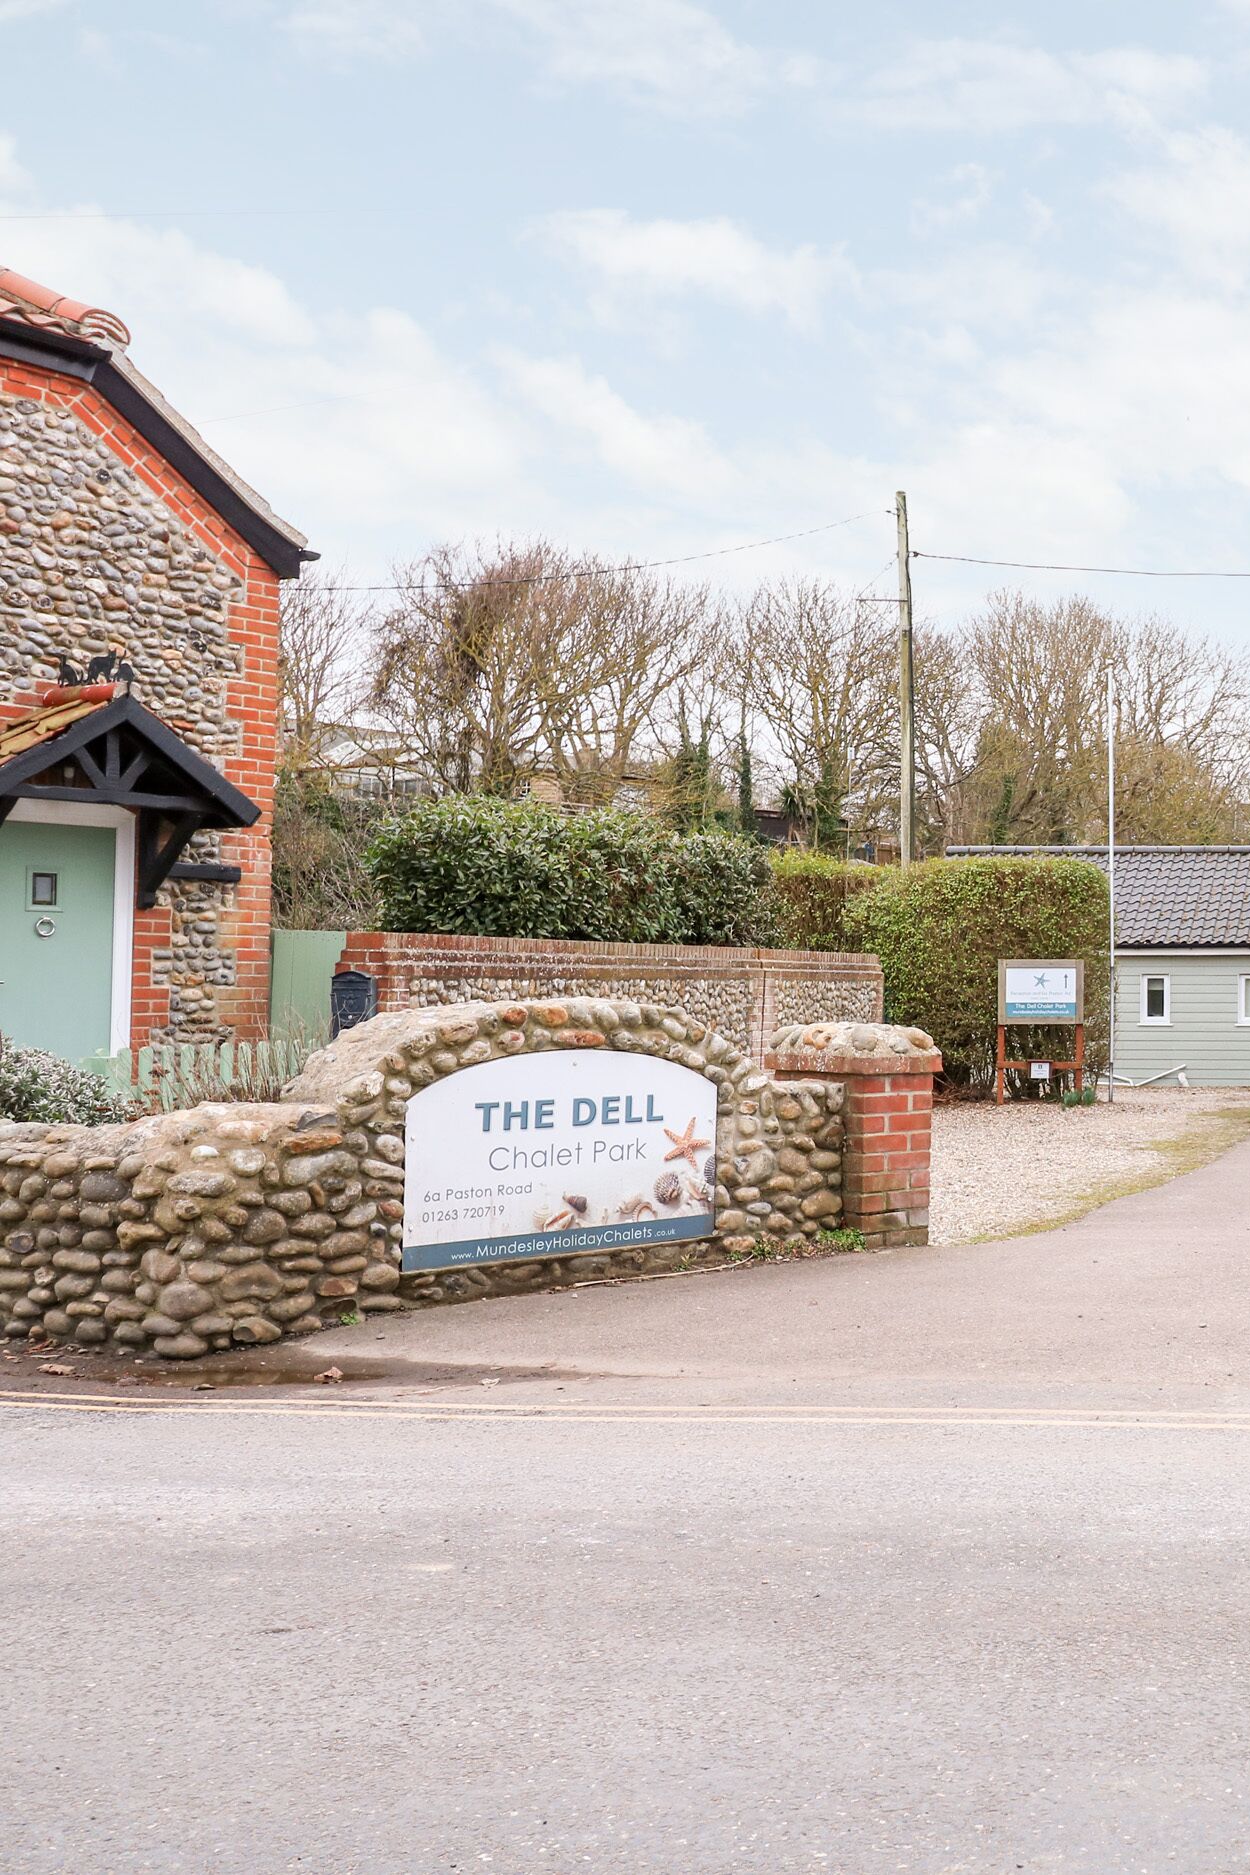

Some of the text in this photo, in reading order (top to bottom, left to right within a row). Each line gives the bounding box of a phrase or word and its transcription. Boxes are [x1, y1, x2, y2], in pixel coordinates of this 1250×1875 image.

[475, 1094, 664, 1131] THE DELL
[489, 1137, 647, 1171] Chalet Park
[424, 1182, 533, 1202] 6a Paston Road
[422, 1205, 505, 1223] 01263 720719
